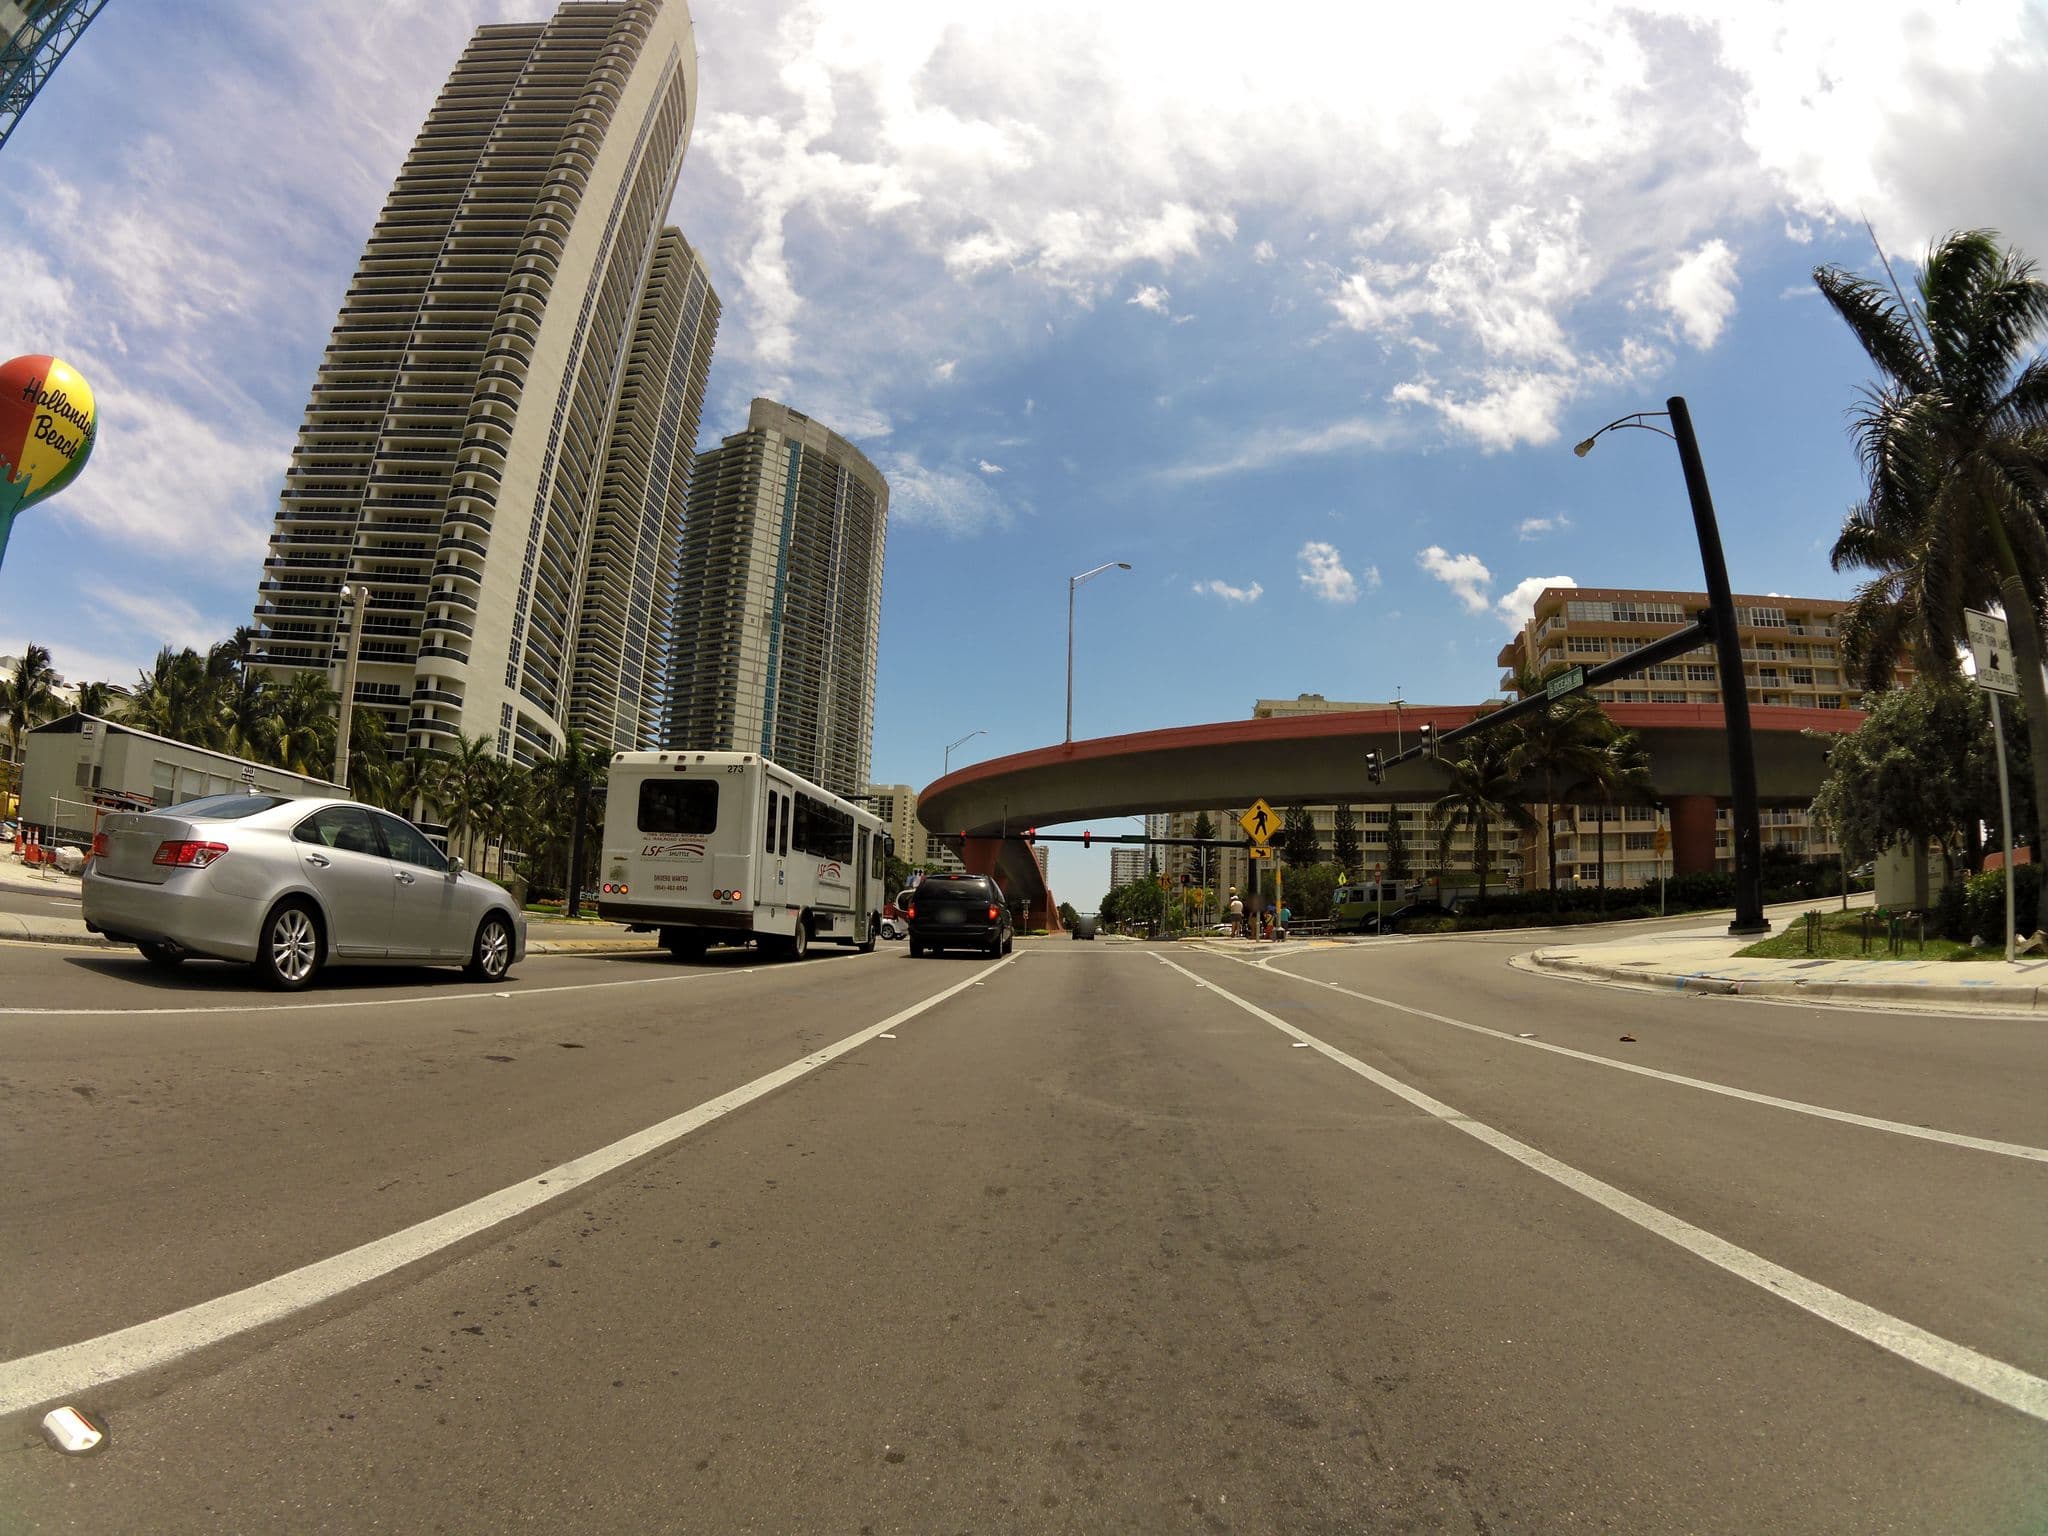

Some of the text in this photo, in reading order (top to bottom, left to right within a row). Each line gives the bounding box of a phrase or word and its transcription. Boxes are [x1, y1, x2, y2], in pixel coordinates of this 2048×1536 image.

[34, 414, 78, 459] Beach
[727, 764, 744, 773] 273
[641, 845, 665, 857] LSF
